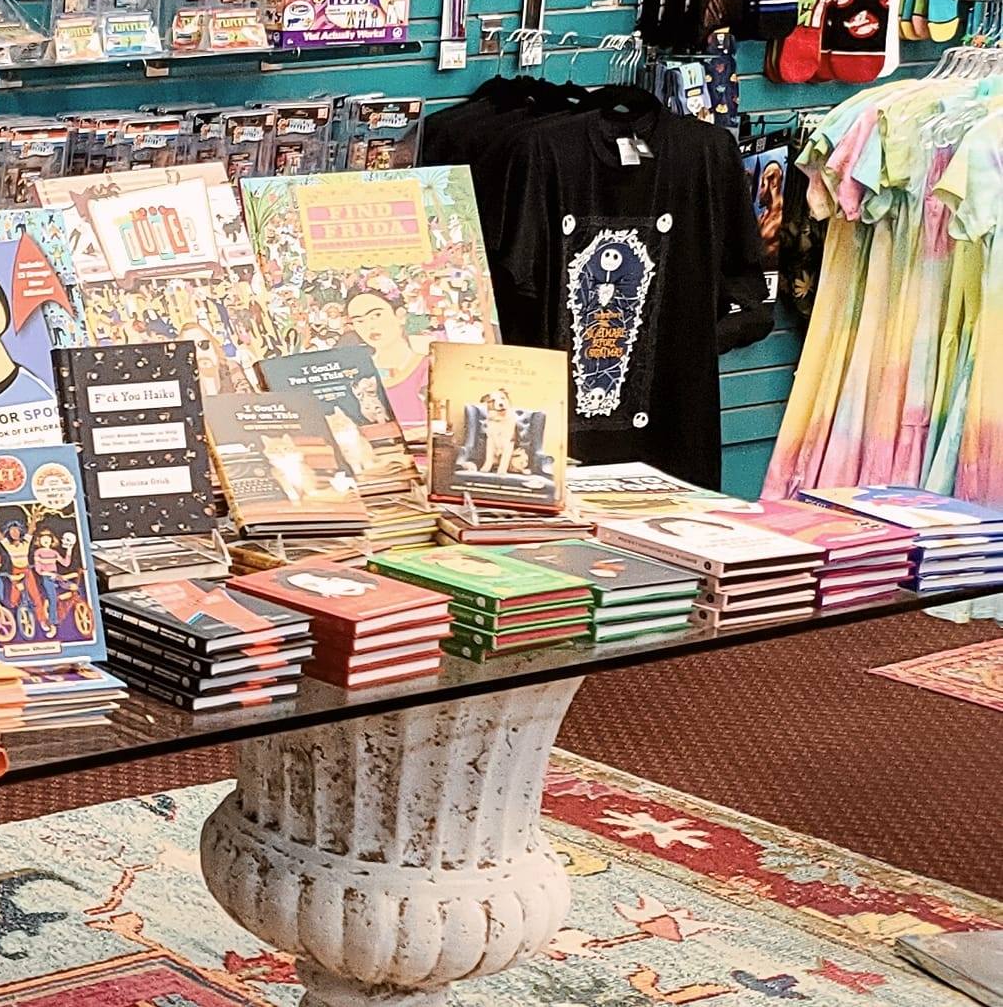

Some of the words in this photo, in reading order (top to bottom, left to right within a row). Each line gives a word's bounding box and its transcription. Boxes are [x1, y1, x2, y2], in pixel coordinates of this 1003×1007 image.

[329, 203, 394, 218] FIND
[325, 221, 405, 239] FRIDA
[301, 367, 309, 375] I
[311, 362, 341, 374] Could
[321, 371, 344, 381] This
[122, 391, 141, 402] You
[144, 389, 175, 400] Haiku
[24, 424, 61, 434] EXPLORA
